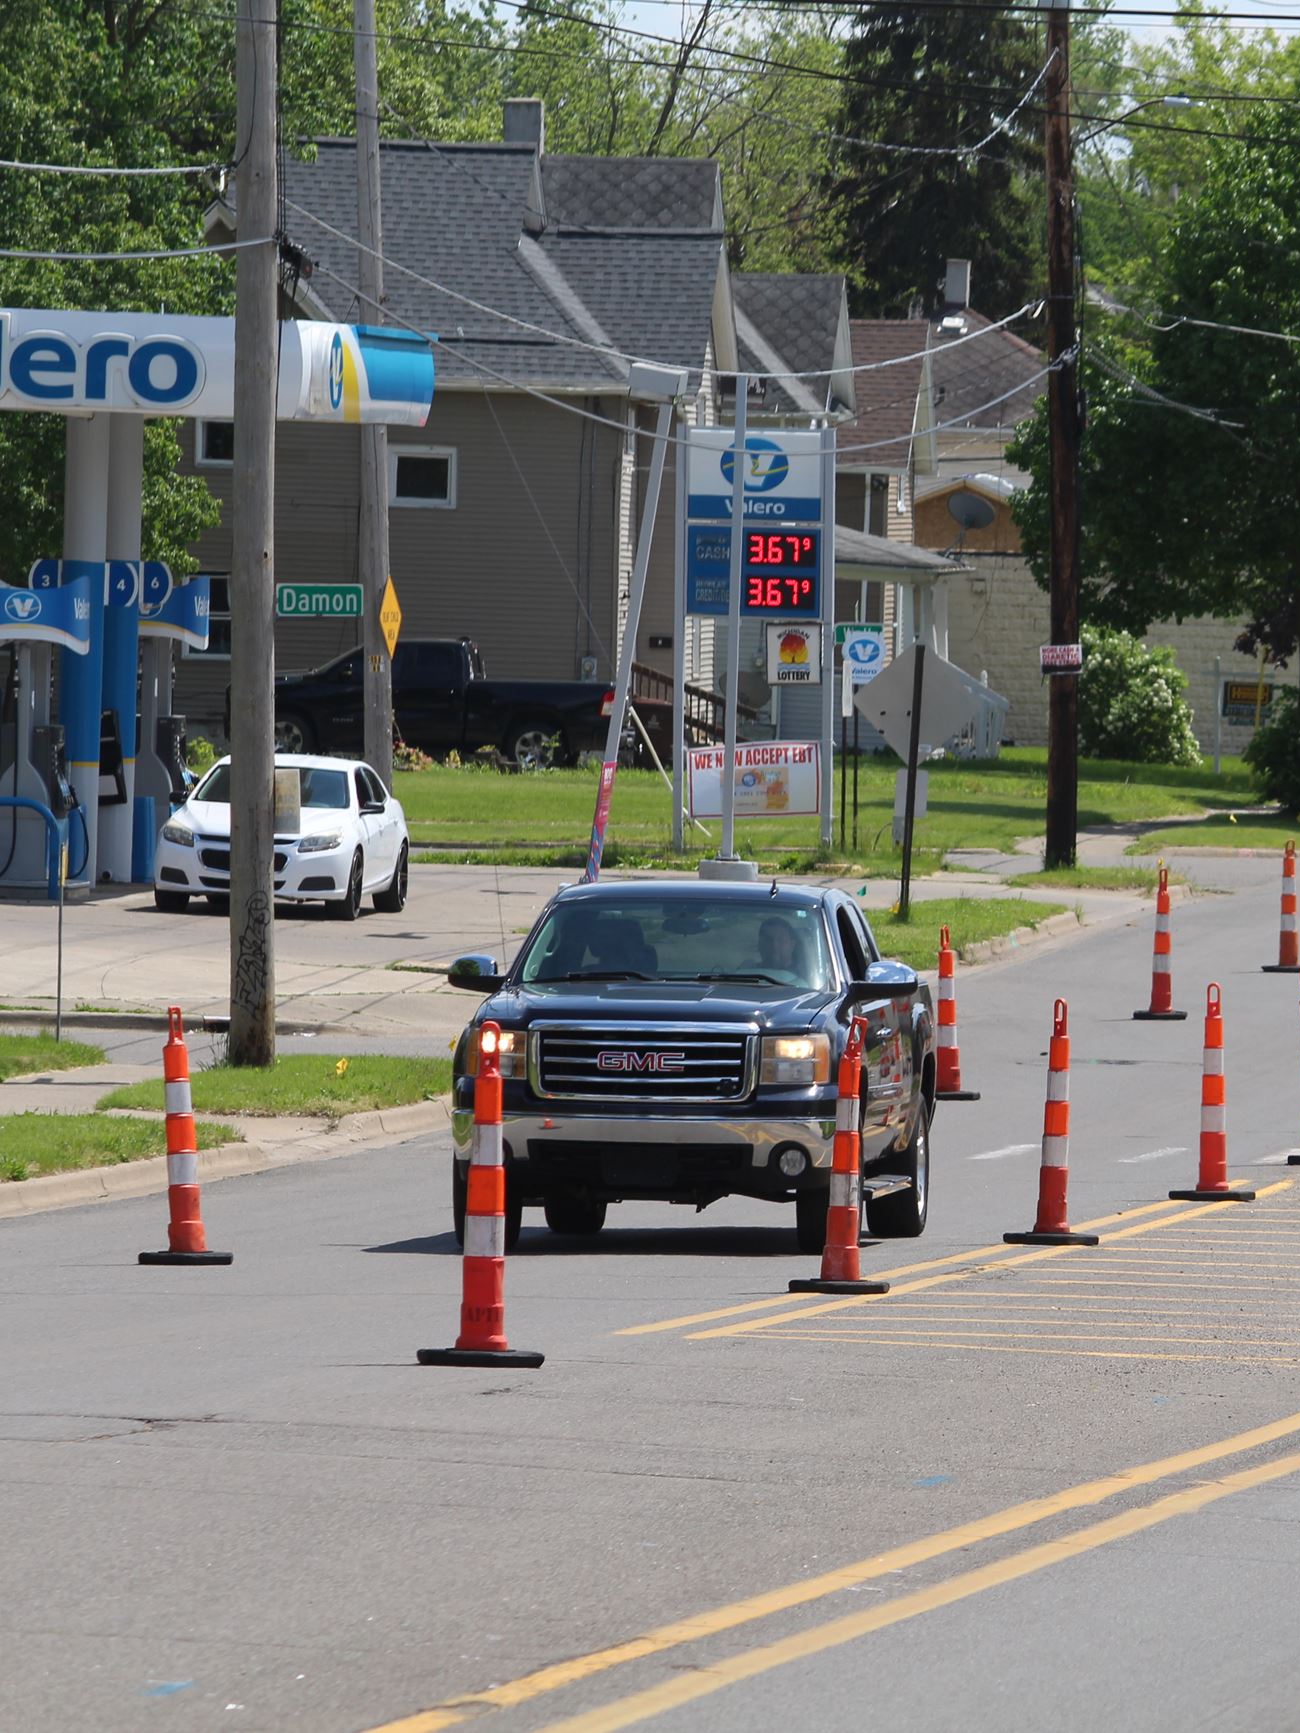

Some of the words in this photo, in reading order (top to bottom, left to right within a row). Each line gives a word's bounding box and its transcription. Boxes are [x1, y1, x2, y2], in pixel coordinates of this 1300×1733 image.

[0, 319, 198, 403] ero
[42, 575, 50, 587] 3
[117, 579, 126, 591] 4
[151, 577, 160, 589] 6
[282, 589, 358, 613] Damon
[777, 627, 810, 640] MICHIGAN
[777, 670, 811, 681] LOTTERY
[695, 753, 712, 770] WE
[715, 750, 743, 769] NW
[745, 746, 790, 766] ACCEPT
[792, 746, 814, 764] EBT
[597, 1050, 686, 1072] GMC
